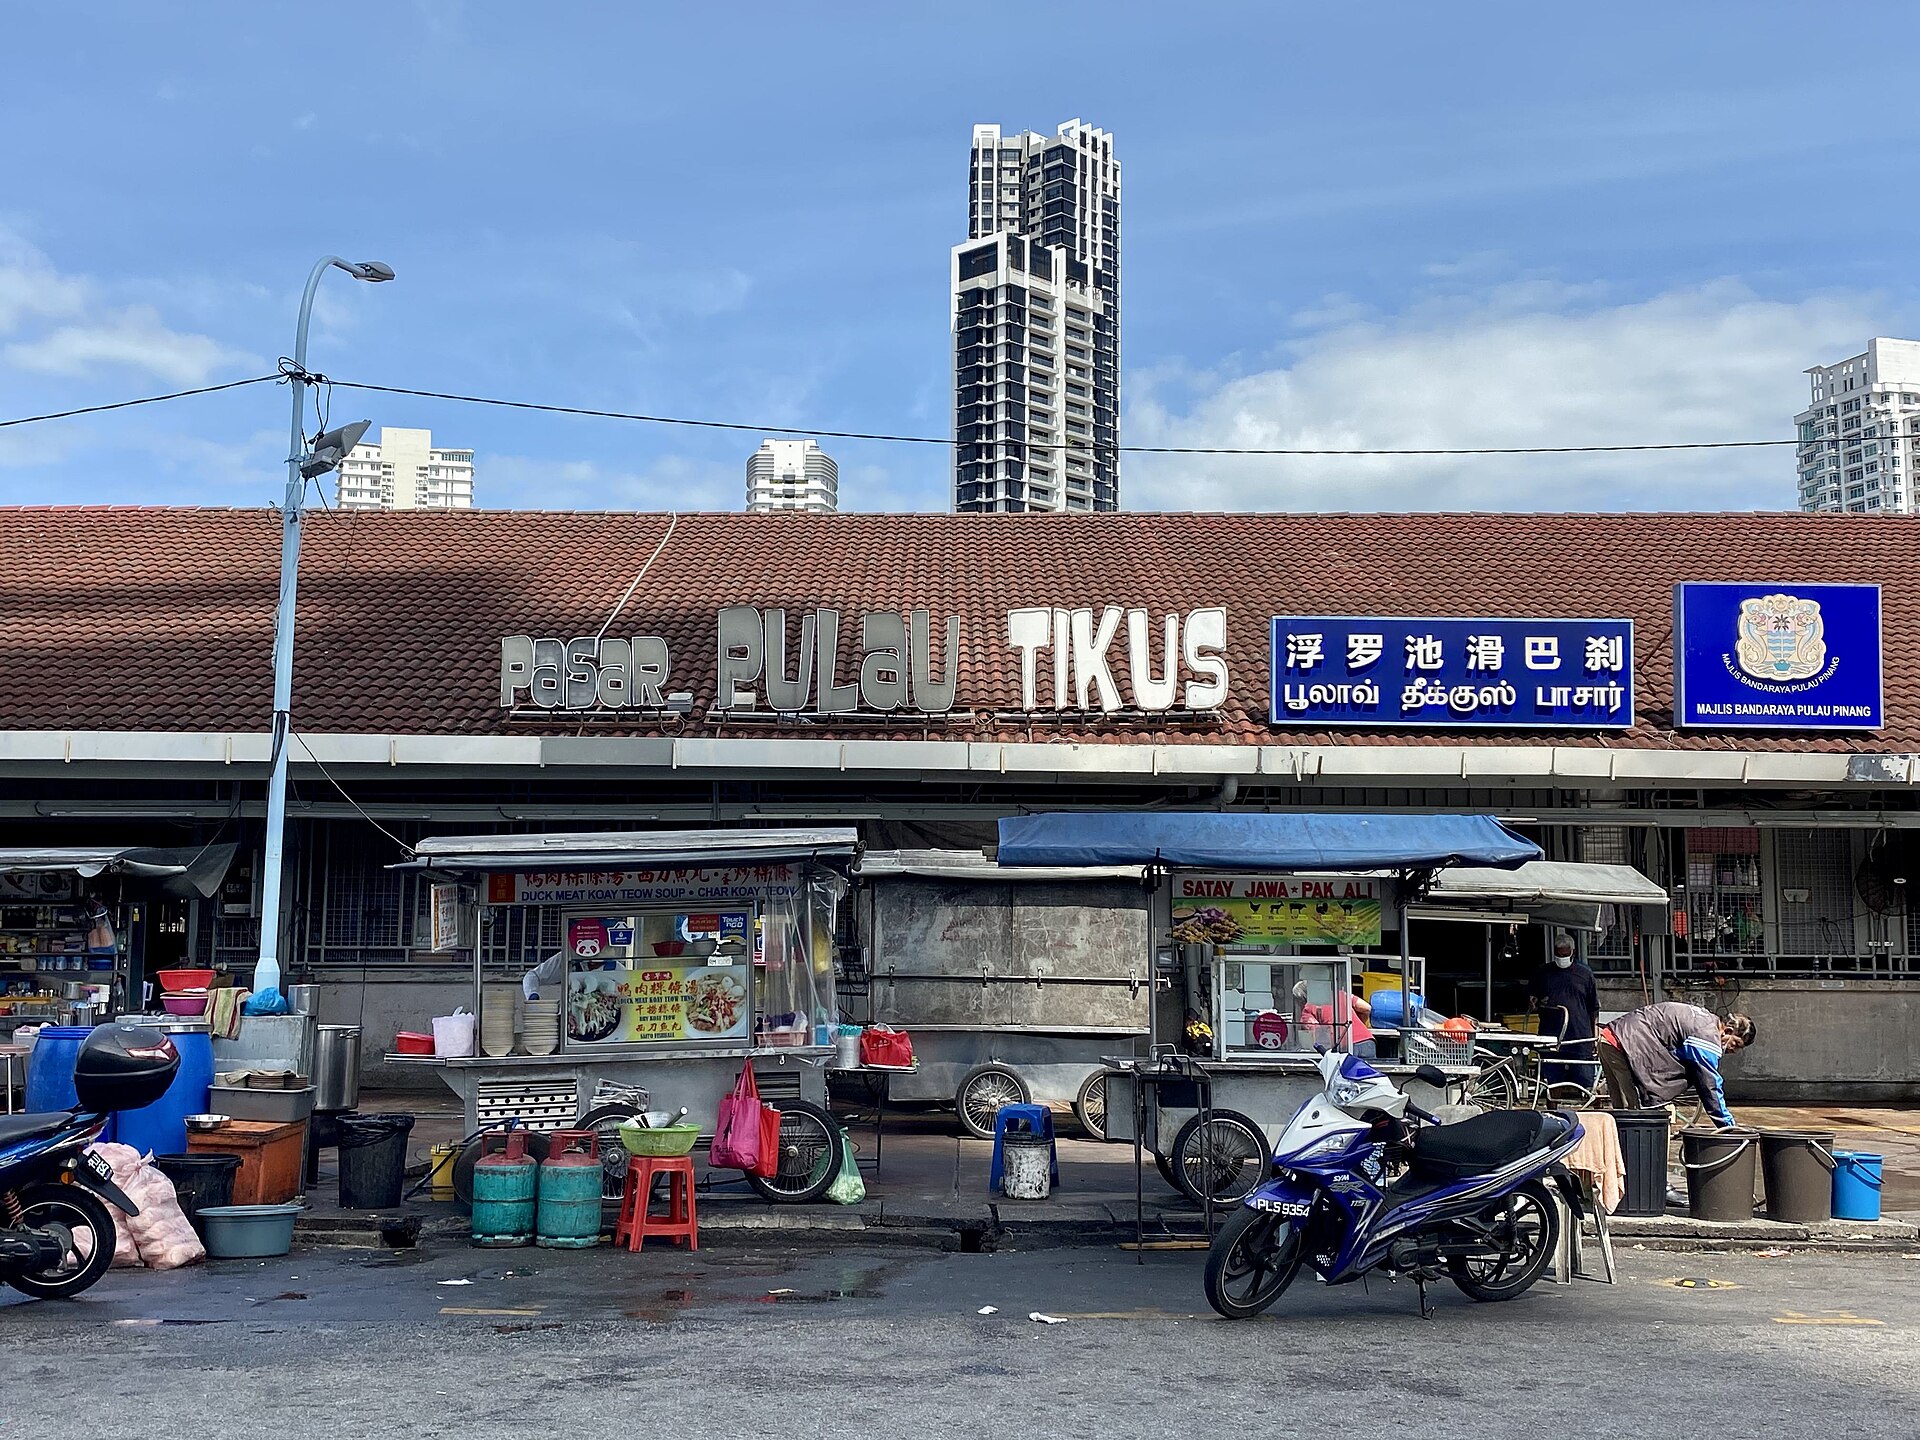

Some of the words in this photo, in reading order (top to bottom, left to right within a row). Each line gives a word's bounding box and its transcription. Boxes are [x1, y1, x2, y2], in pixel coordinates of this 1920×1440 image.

[1007, 605, 1229, 713] TIKUS
[1721, 653, 1741, 680] MAJLIS
[1740, 676, 1791, 694] BANDARAYA
[1791, 678, 1819, 694] PULAU
[1818, 656, 1840, 684] PINANG
[1696, 703, 1732, 715] MAJLIS
[1735, 704, 1795, 716] BANDARAYA
[1797, 705, 1830, 716] PULAU
[1833, 705, 1871, 717] PINANG
[521, 891, 552, 901] DUCK
[555, 890, 585, 900] MEAT
[588, 889, 618, 900] KOAY
[621, 888, 653, 899] TEOW
[655, 888, 685, 898] SOUP
[697, 887, 729, 897] CHAR
[731, 886, 761, 896] KOAY
[1183, 880, 1235, 897] SATAY
[1244, 881, 1289, 898] JAWA
[1302, 882, 1334, 898] PAK
[1344, 882, 1372, 899] ALI
[1332, 1174, 1350, 1182] SYM
[1257, 1198, 1281, 1213] PLS
[1281, 1203, 1311, 1218] 9354
